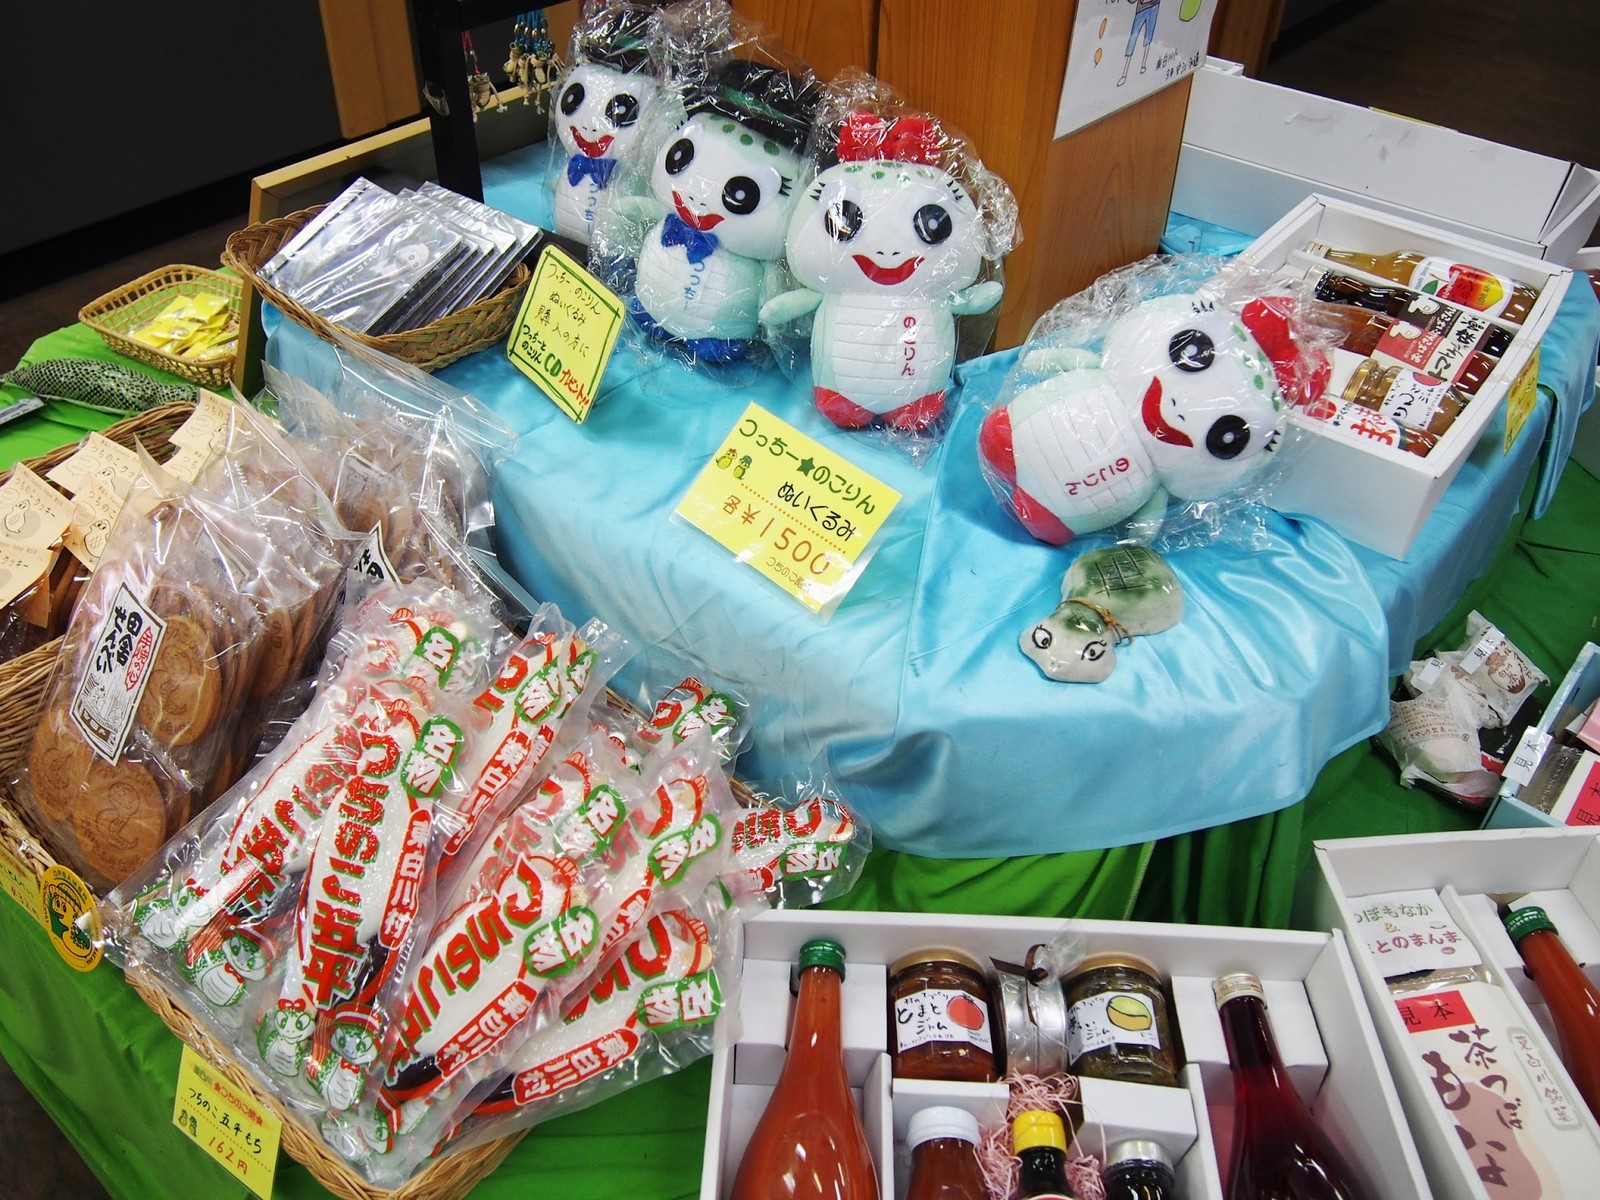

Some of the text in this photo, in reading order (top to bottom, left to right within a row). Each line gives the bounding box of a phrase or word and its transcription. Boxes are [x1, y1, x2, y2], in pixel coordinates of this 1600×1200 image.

[548, 290, 588, 326] ぬいぐるみ
[521, 340, 543, 365] のこりん
[543, 352, 562, 378] CD
[95, 605, 128, 674] せんべい
[116, 611, 144, 667] 田舎
[405, 724, 457, 795] 名物
[1513, 740, 1541, 772] 見本
[652, 818, 718, 881] 名物
[382, 819, 430, 940] 東白川村
[527, 910, 595, 974] 名物
[442, 987, 532, 1071] 東白川村
[643, 979, 717, 1025] 名物
[896, 1002, 942, 1025] とまと
[1399, 999, 1456, 1027] 見本
[521, 1032, 630, 1098] 東白川村
[188, 1087, 263, 1155] つちのこ五平もち
[208, 1136, 249, 1176] 162円
